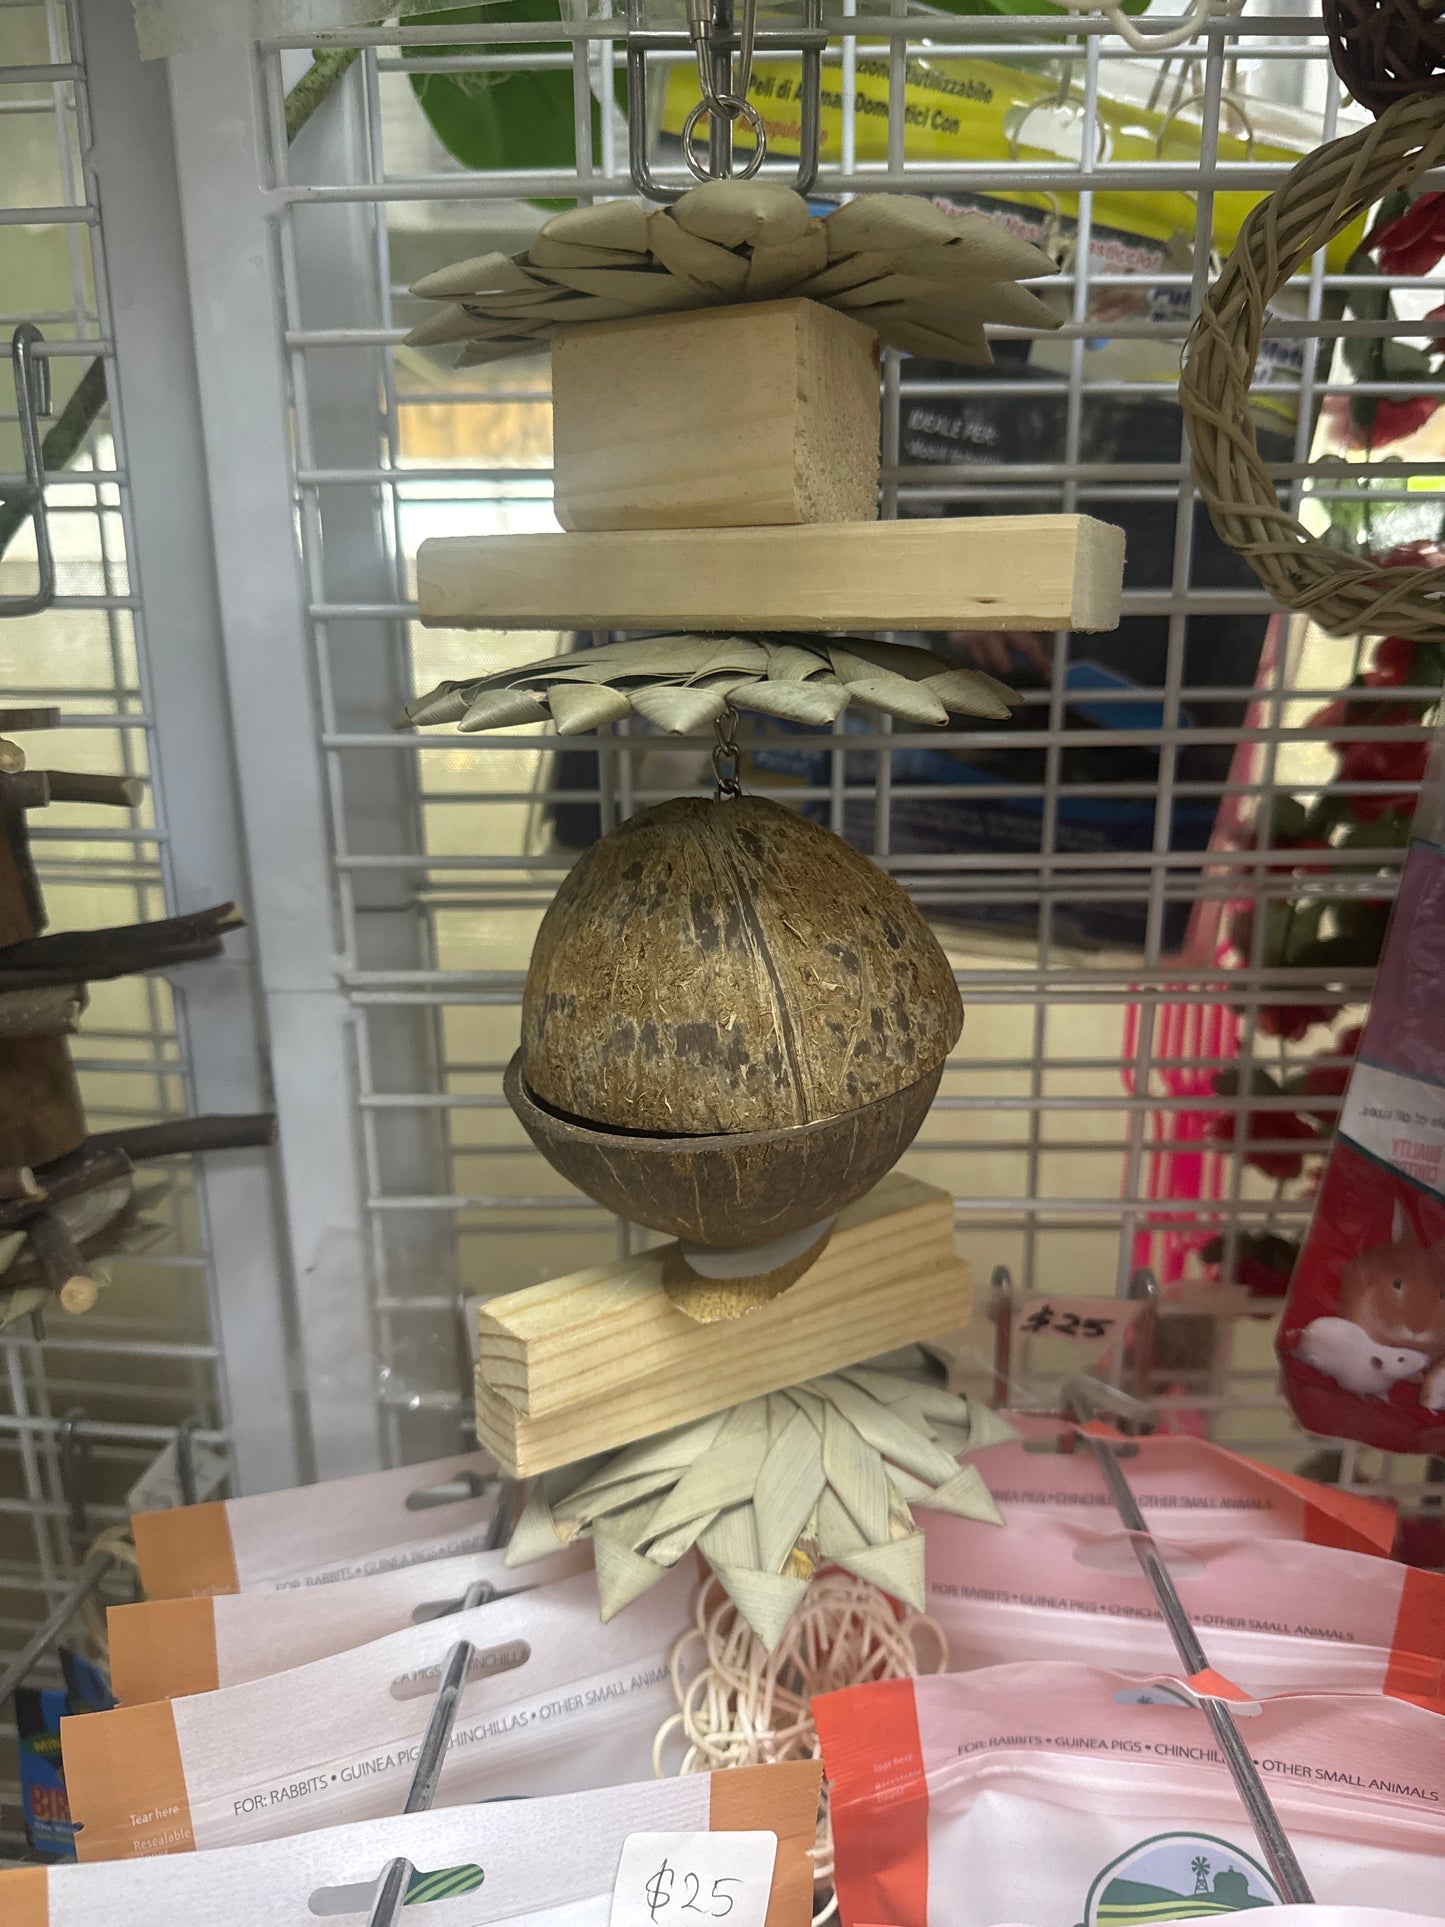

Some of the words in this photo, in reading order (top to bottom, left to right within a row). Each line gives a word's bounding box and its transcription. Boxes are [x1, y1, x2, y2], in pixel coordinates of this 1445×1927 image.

[1020, 1304, 1115, 1337] $25
[961, 1585, 1010, 1603] RABBITS
[1020, 1591, 1067, 1610] GUINEA
[1069, 1599, 1098, 1614] PIGS
[1202, 1613, 1246, 1629] OTHER
[1249, 1618, 1290, 1635] SMALL
[1293, 1625, 1355, 1642] ANIMALS
[233, 1794, 268, 1817] FOR:
[270, 1774, 329, 1806] RABBITS
[340, 1754, 396, 1783] GUINEA
[397, 1745, 423, 1767] PIG
[539, 1694, 584, 1721] OTHER
[585, 1684, 627, 1706] SMALL
[630, 1662, 686, 1691] ANIMAS
[957, 1740, 988, 1756] FOR:
[988, 1734, 1043, 1748] RABBITS
[1054, 1737, 1109, 1751] GUINEA
[1111, 1740, 1142, 1753] PIGS
[1262, 1758, 1313, 1778] OTHER
[1315, 1768, 1366, 1788] SMALL
[1368, 1778, 1440, 1802] ANIMALS
[130, 1812, 154, 1827] Tear
[154, 1805, 180, 1820] here
[133, 1828, 191, 1851] Resealable
[645, 1857, 745, 1925] $25
